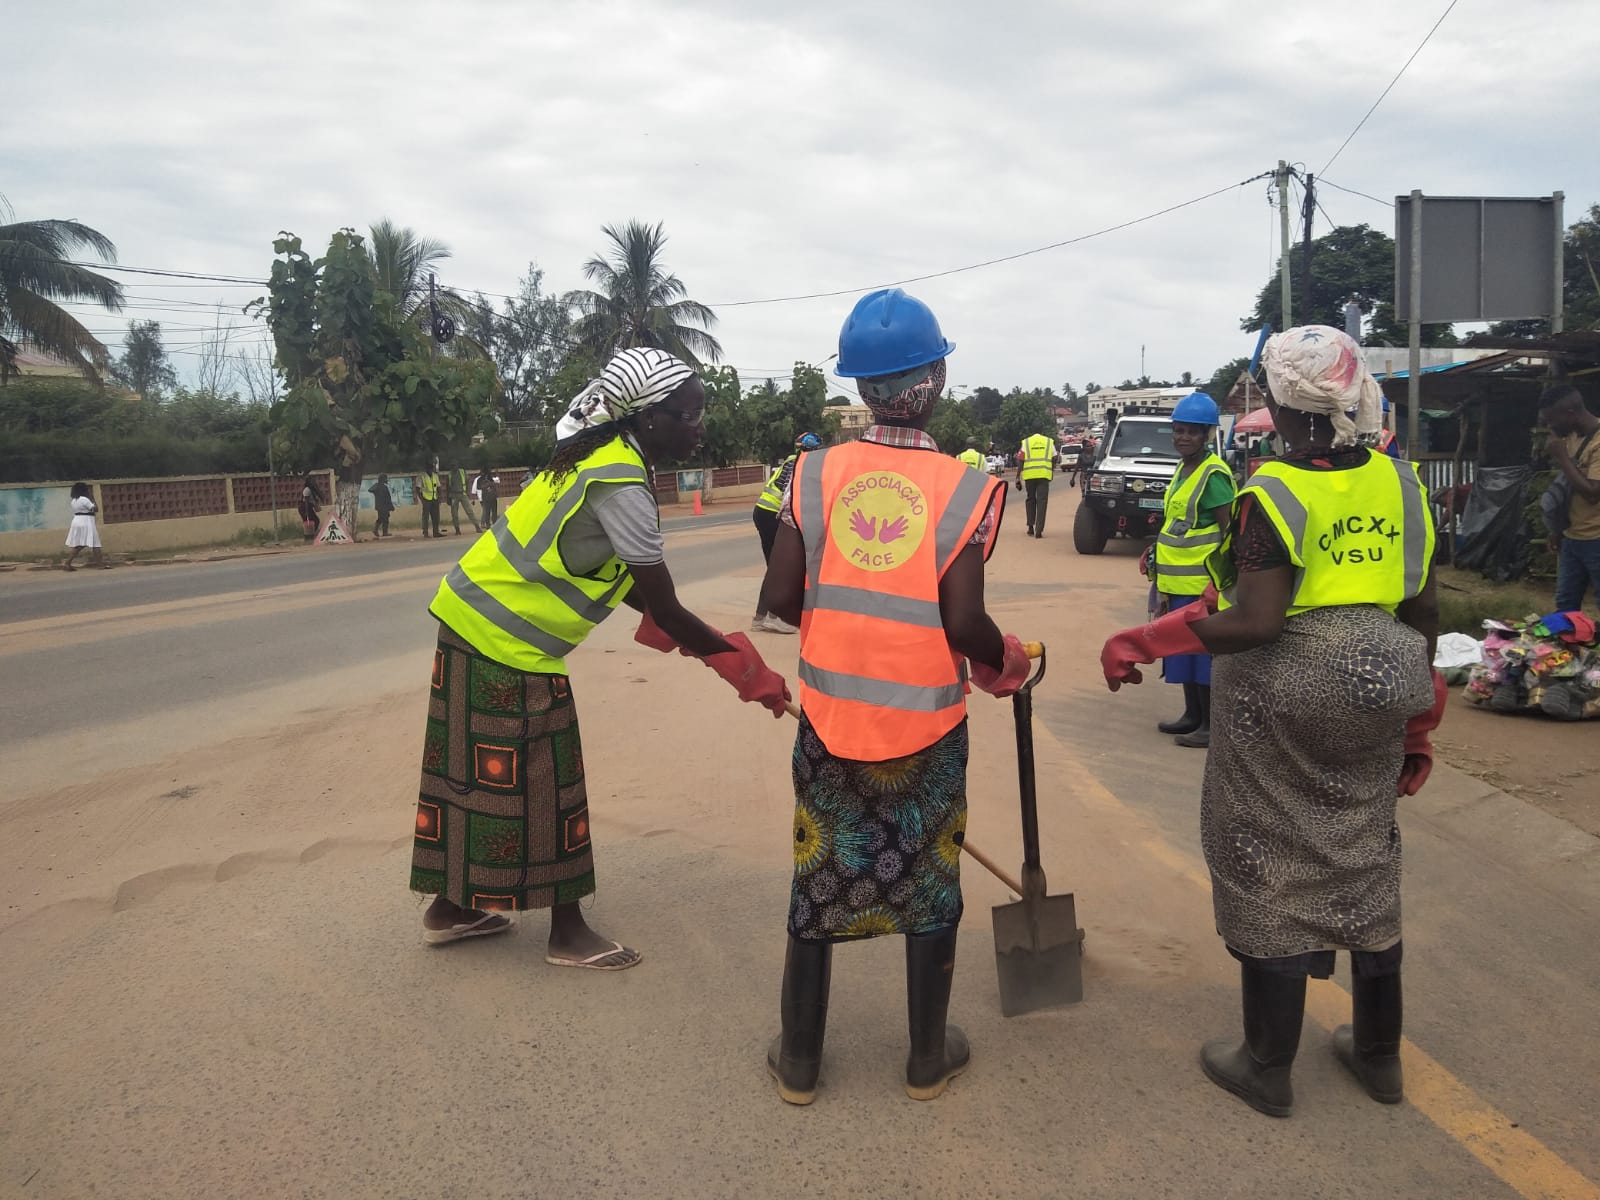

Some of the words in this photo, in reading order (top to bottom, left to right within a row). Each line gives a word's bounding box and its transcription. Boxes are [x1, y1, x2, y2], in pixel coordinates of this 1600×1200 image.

[841, 476, 924, 516] ASSOCIAÇÃO
[1318, 516, 1401, 551] CMCXX
[851, 547, 895, 566] FACE
[1331, 547, 1383, 565] VSU
